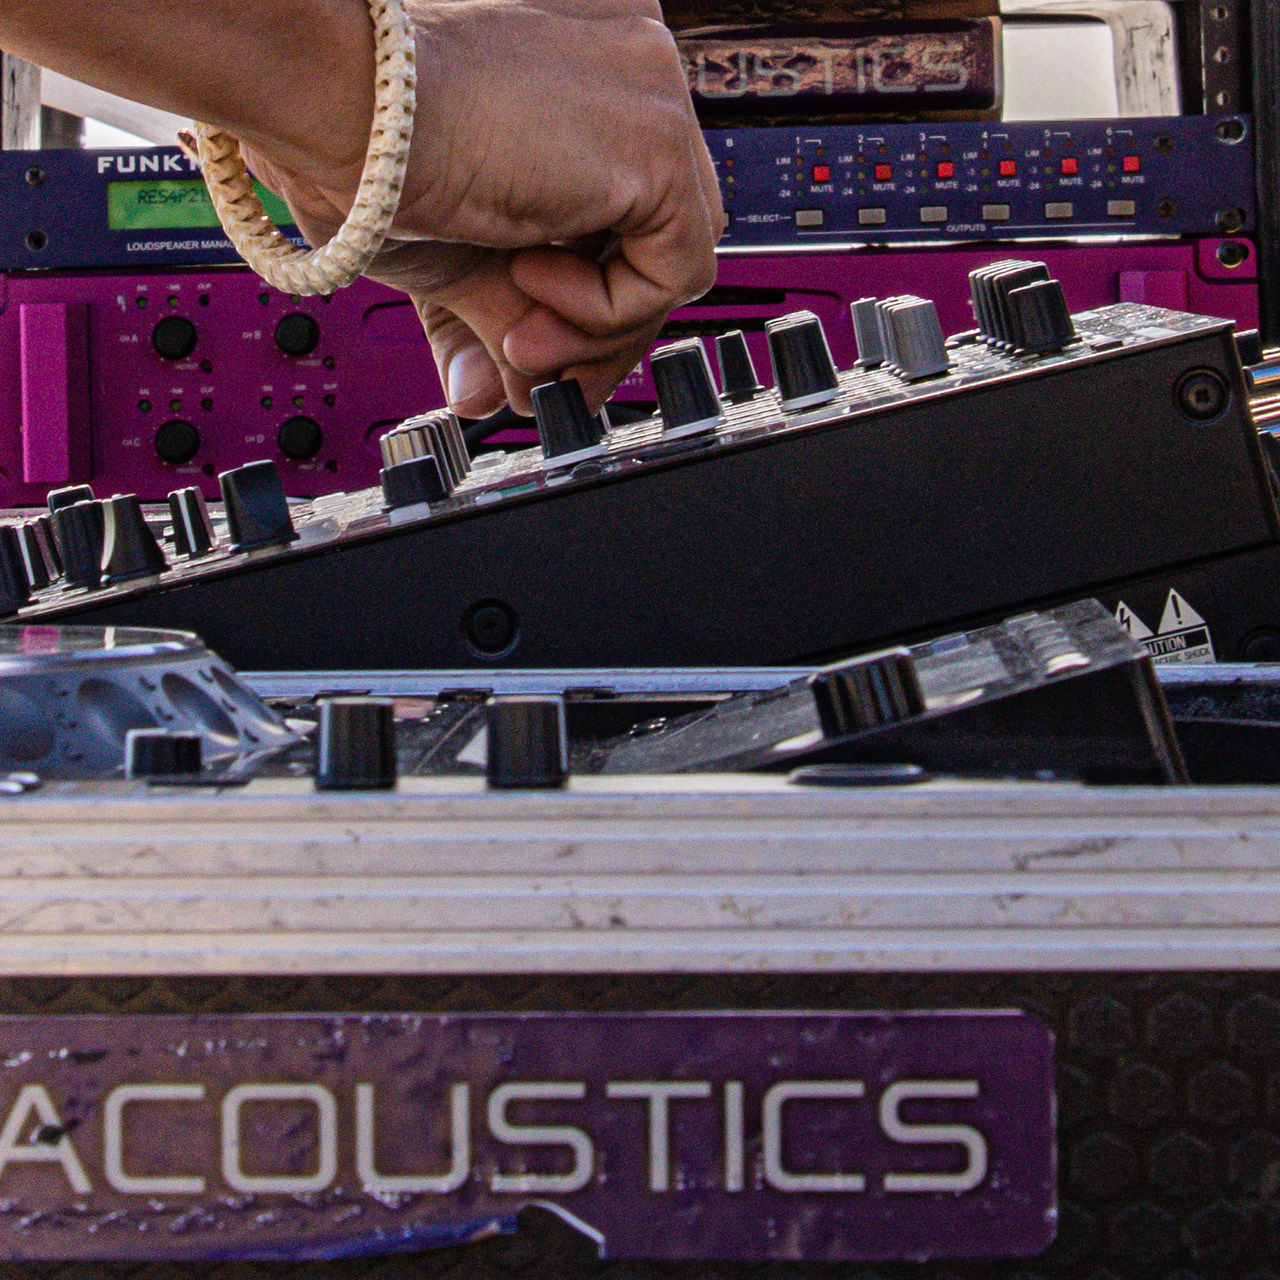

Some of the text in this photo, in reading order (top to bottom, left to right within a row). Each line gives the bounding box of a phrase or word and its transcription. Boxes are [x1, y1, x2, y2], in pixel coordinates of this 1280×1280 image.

[682, 43, 968, 99] USTICS
[997, 179, 1021, 188] MUTE
[1059, 177, 1083, 186] MUTE
[1121, 175, 1146, 185] MUTE
[810, 184, 834, 193] MUTE
[872, 182, 897, 192] MUTE
[934, 181, 959, 190] MUTE
[747, 214, 780, 223] SELECT
[946, 223, 987, 233] OUTPUTS
[127, 240, 198, 251] LOUDSPEAKER
